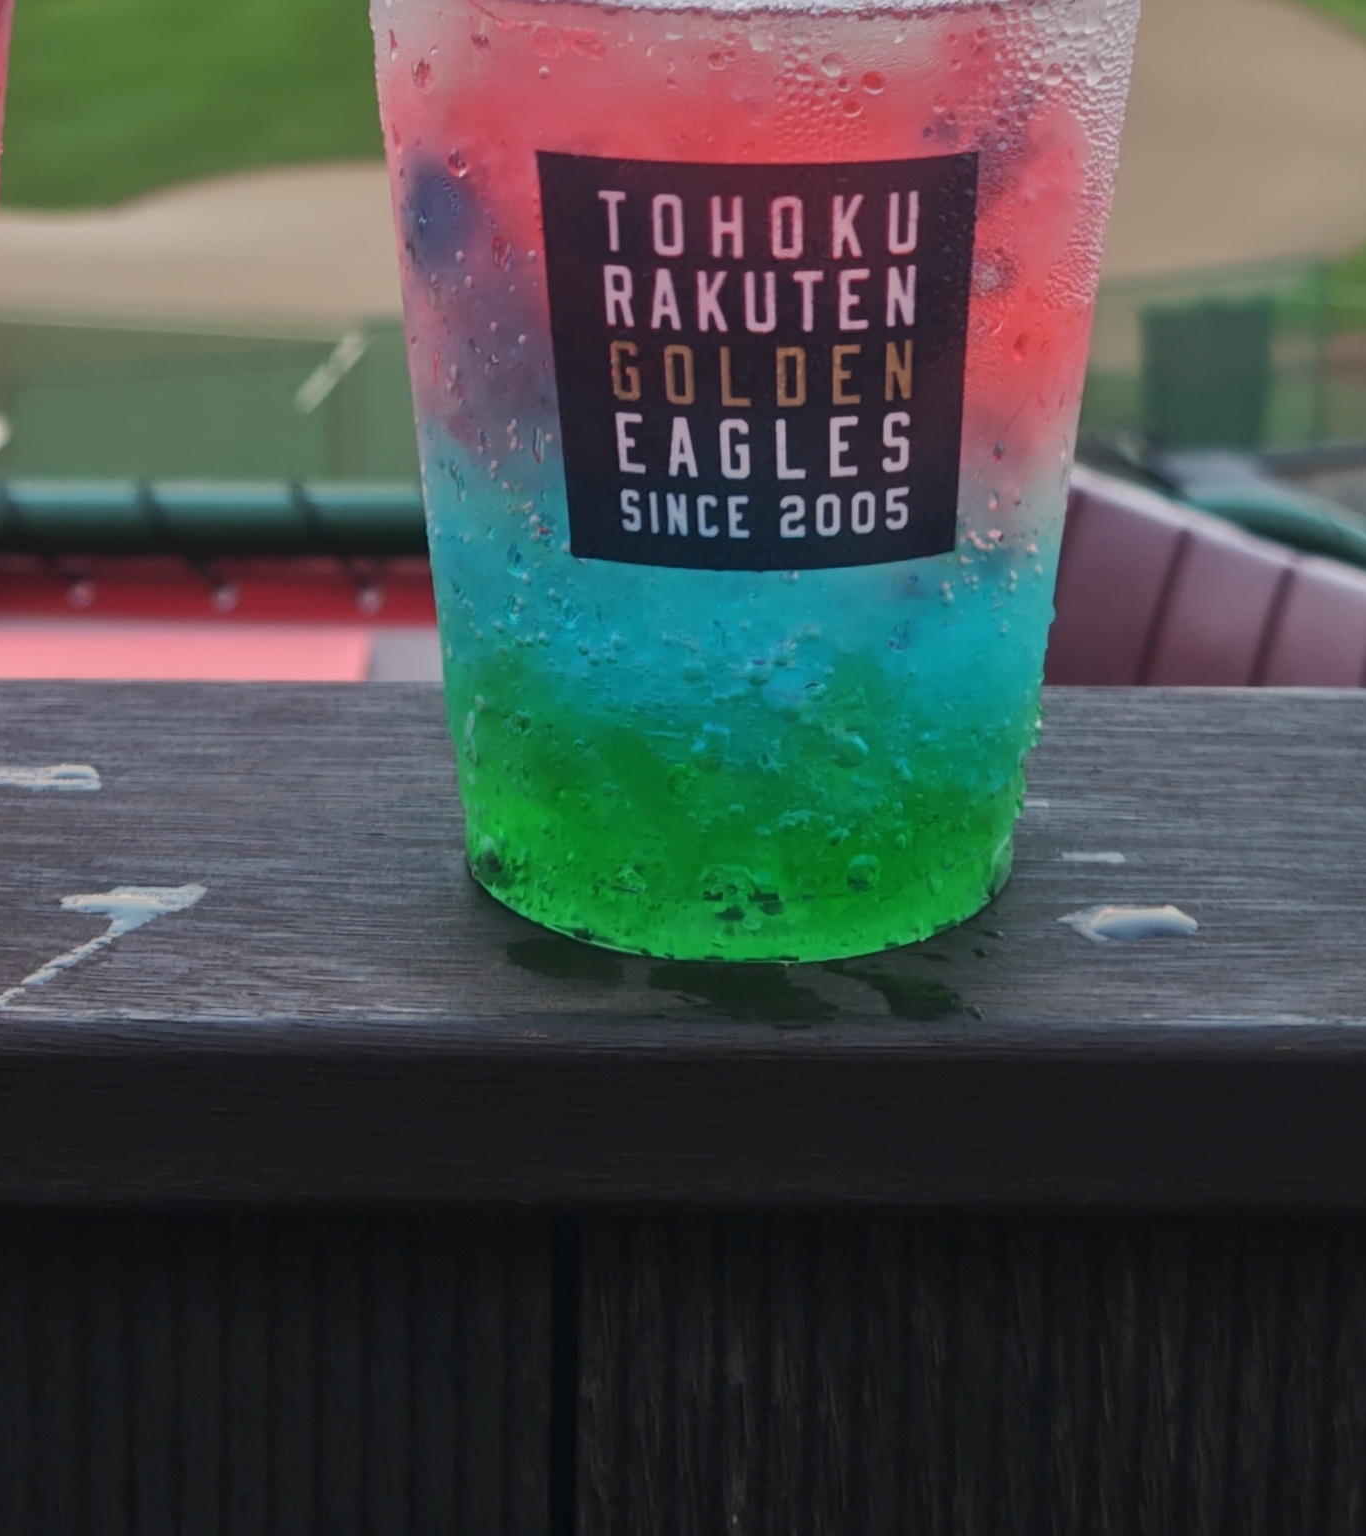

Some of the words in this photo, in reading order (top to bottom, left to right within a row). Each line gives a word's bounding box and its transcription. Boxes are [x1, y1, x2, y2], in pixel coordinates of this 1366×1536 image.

[598, 190, 920, 259] TOHOKU
[603, 264, 917, 333] RAKUTEN
[610, 339, 914, 408] GOLDEN
[615, 411, 912, 480] EAGLES
[620, 489, 751, 539] SINCE
[779, 486, 910, 539] 2005
